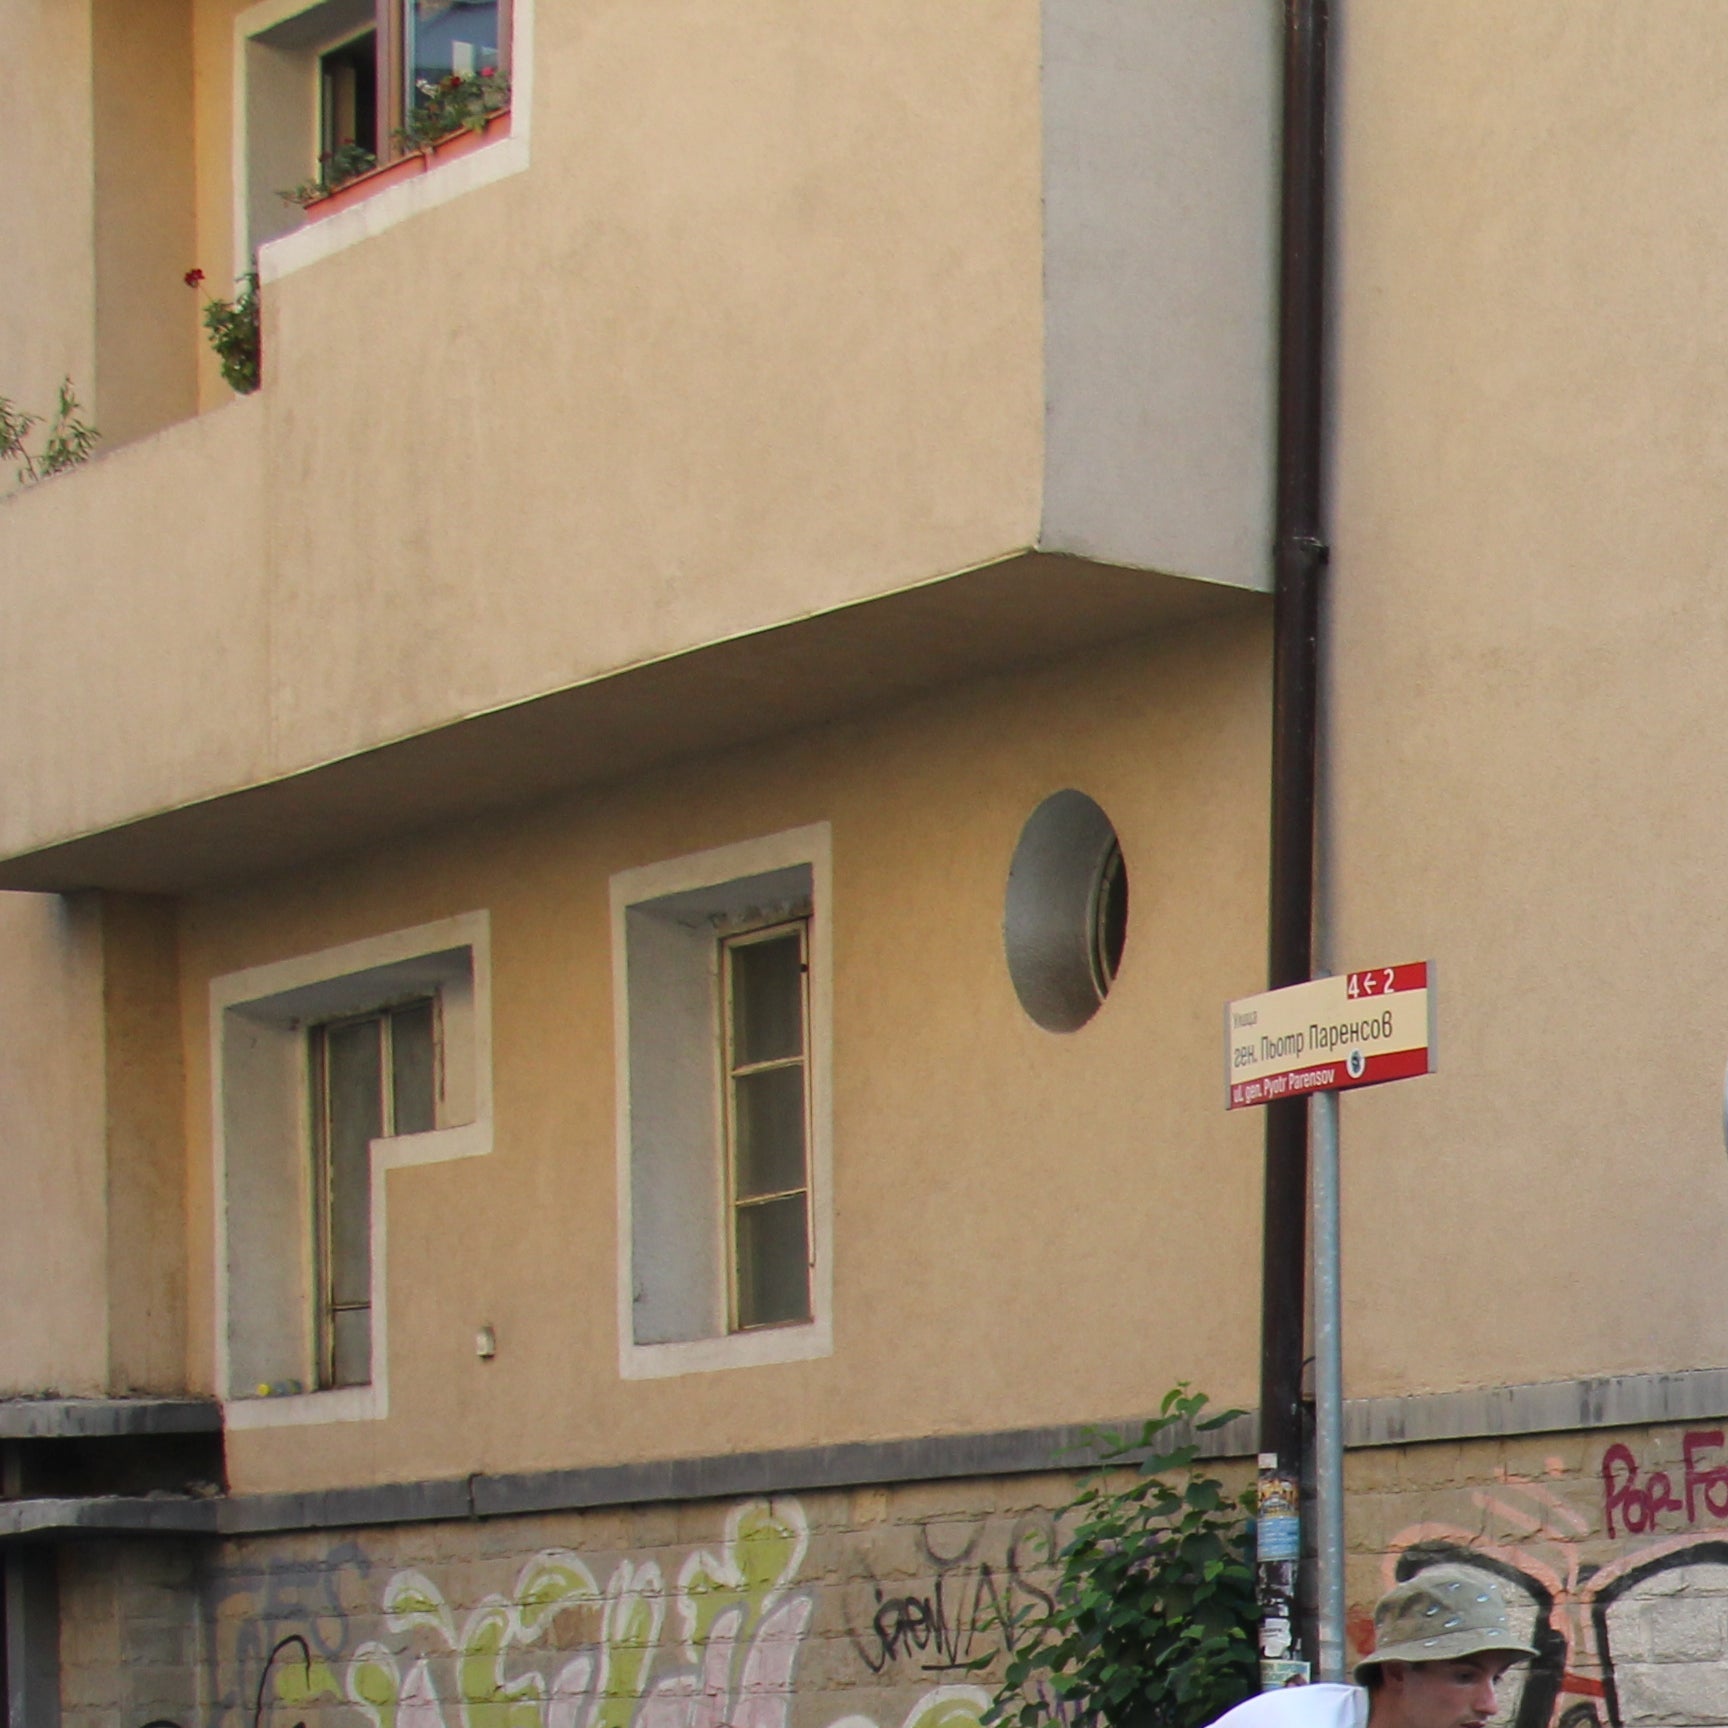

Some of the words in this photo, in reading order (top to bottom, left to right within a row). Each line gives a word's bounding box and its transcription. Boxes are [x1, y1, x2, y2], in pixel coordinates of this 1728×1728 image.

[1347, 974, 1361, 998] 4
[1383, 968, 1395, 993] 2
[1261, 1032, 1305, 1060] Пьотр
[1309, 1010, 1393, 1052] Паренсов
[1288, 1068, 1335, 1090] Parensov
